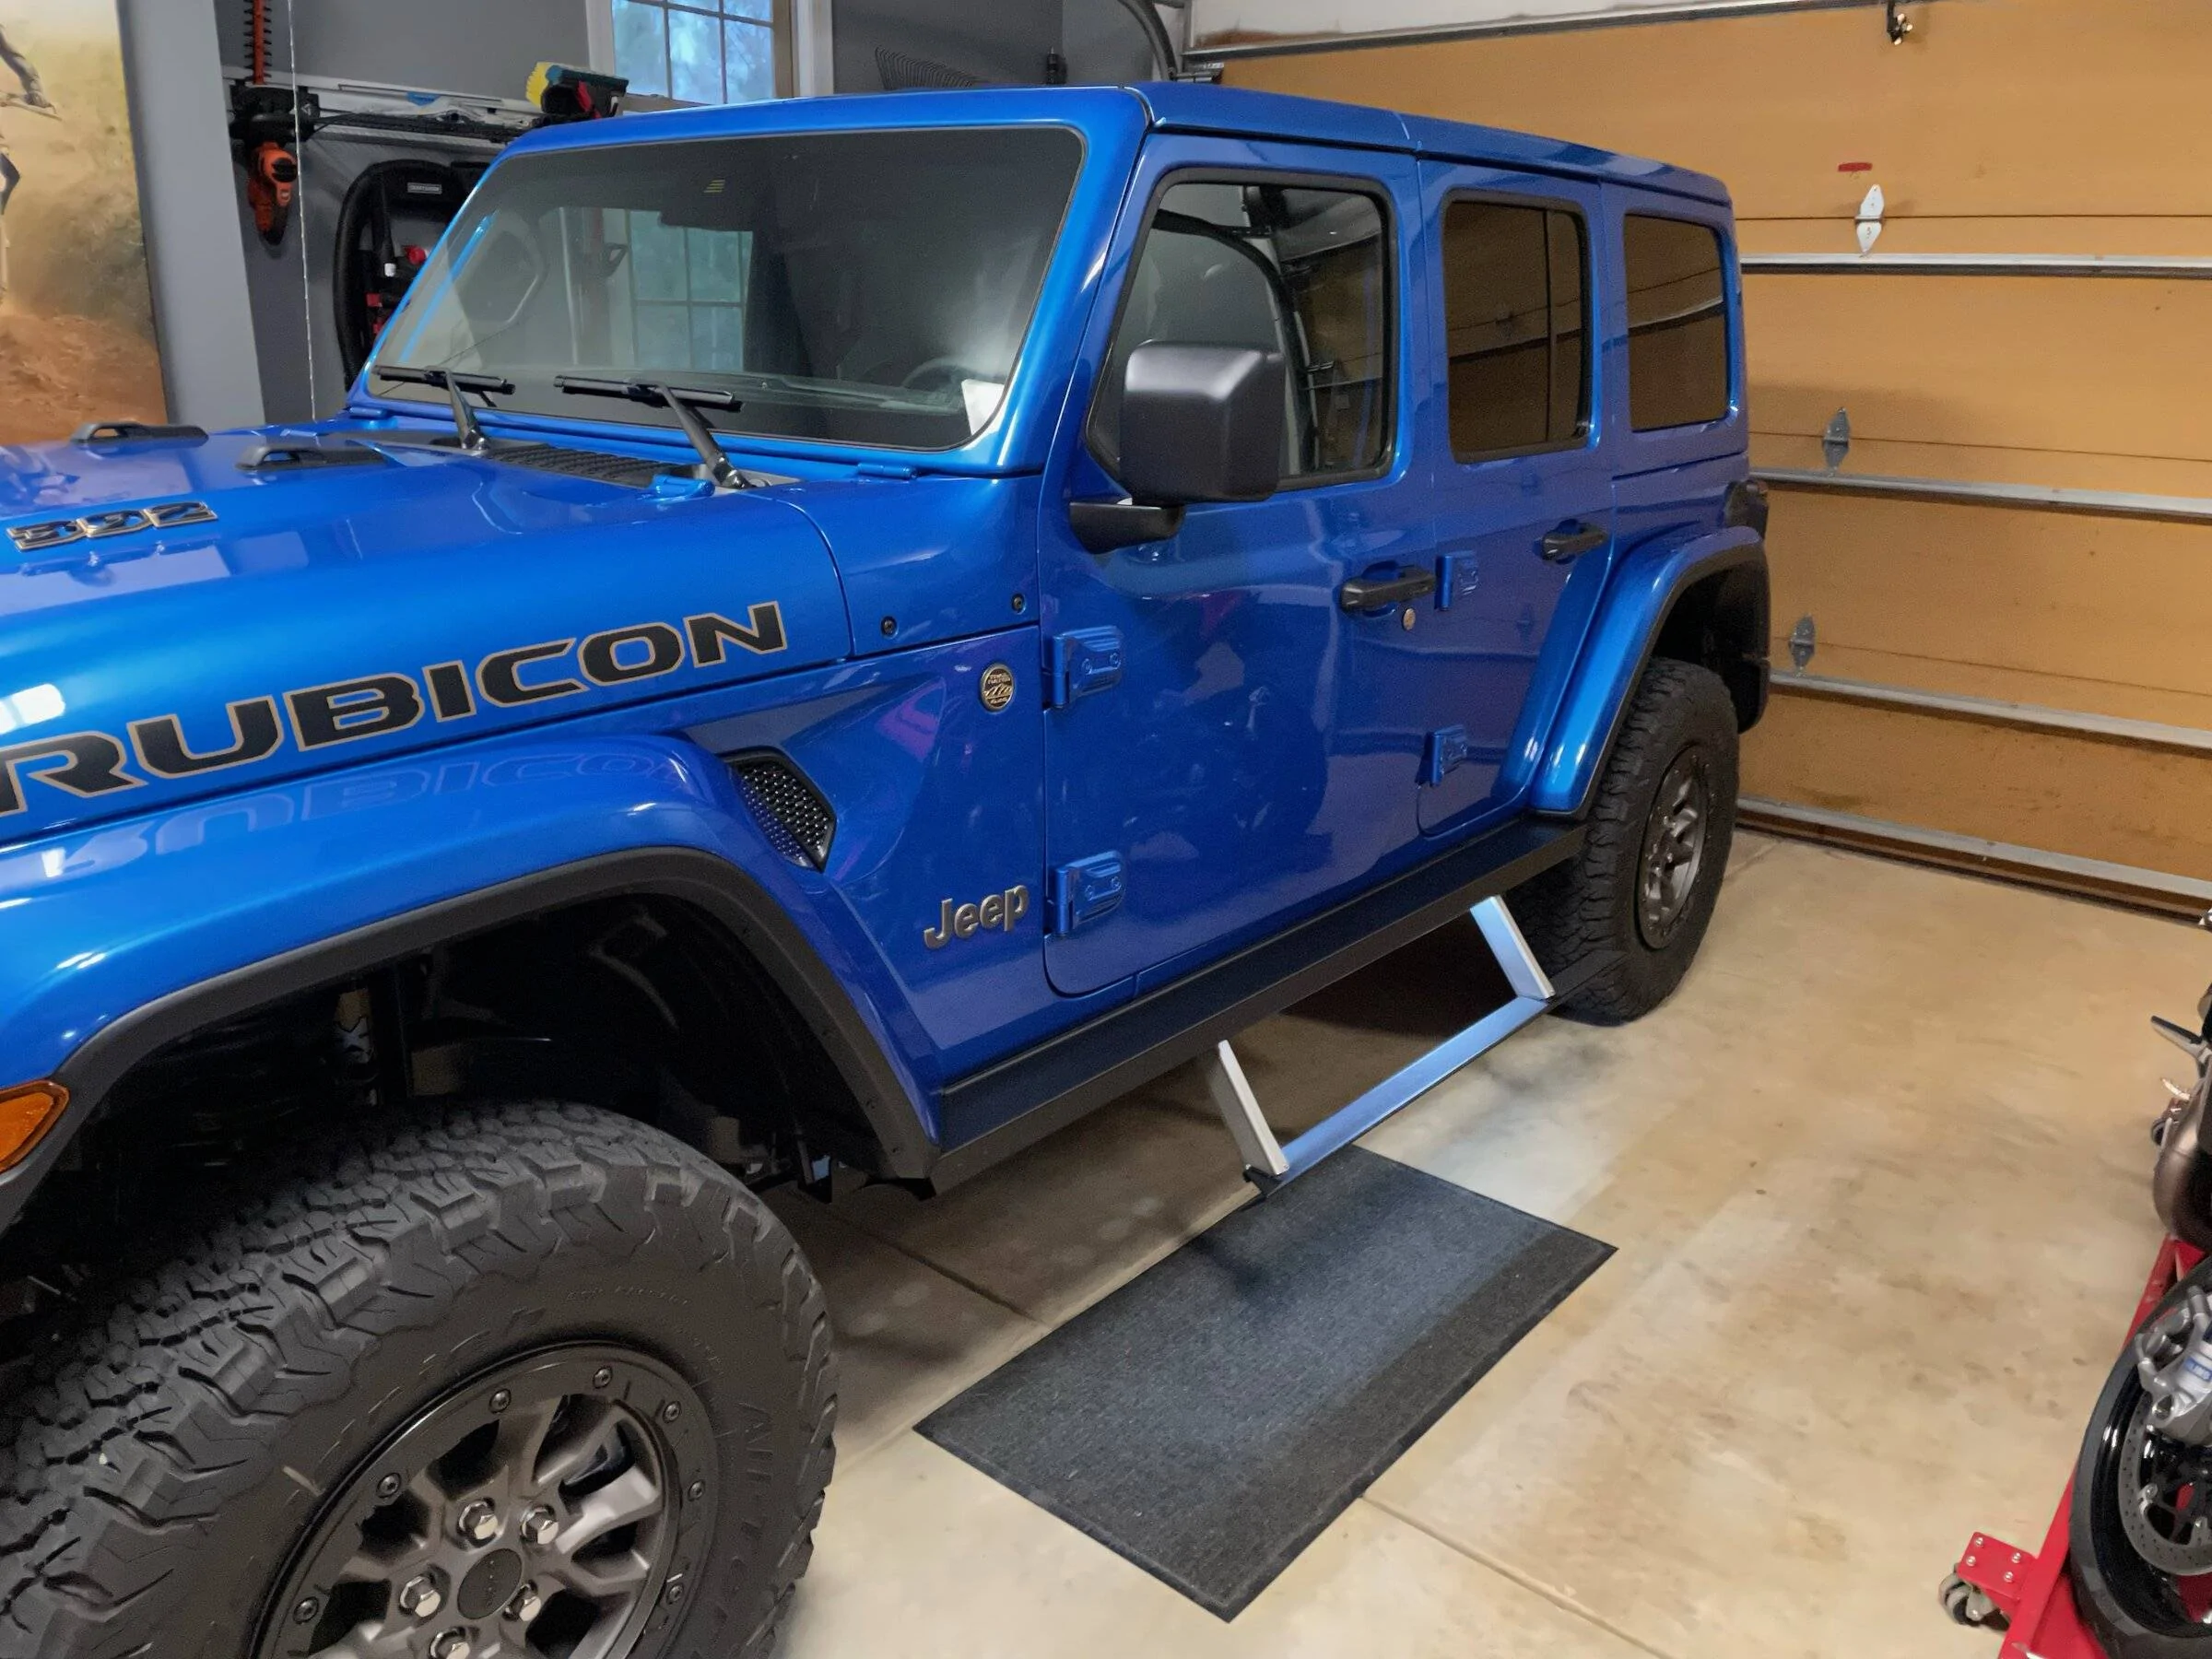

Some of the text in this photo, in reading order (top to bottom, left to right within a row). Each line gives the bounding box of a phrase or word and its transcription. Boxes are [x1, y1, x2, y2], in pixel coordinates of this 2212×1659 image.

[6, 501, 218, 550] 392
[0, 601, 787, 817] RUBICON
[924, 884, 1030, 949] Jeep
